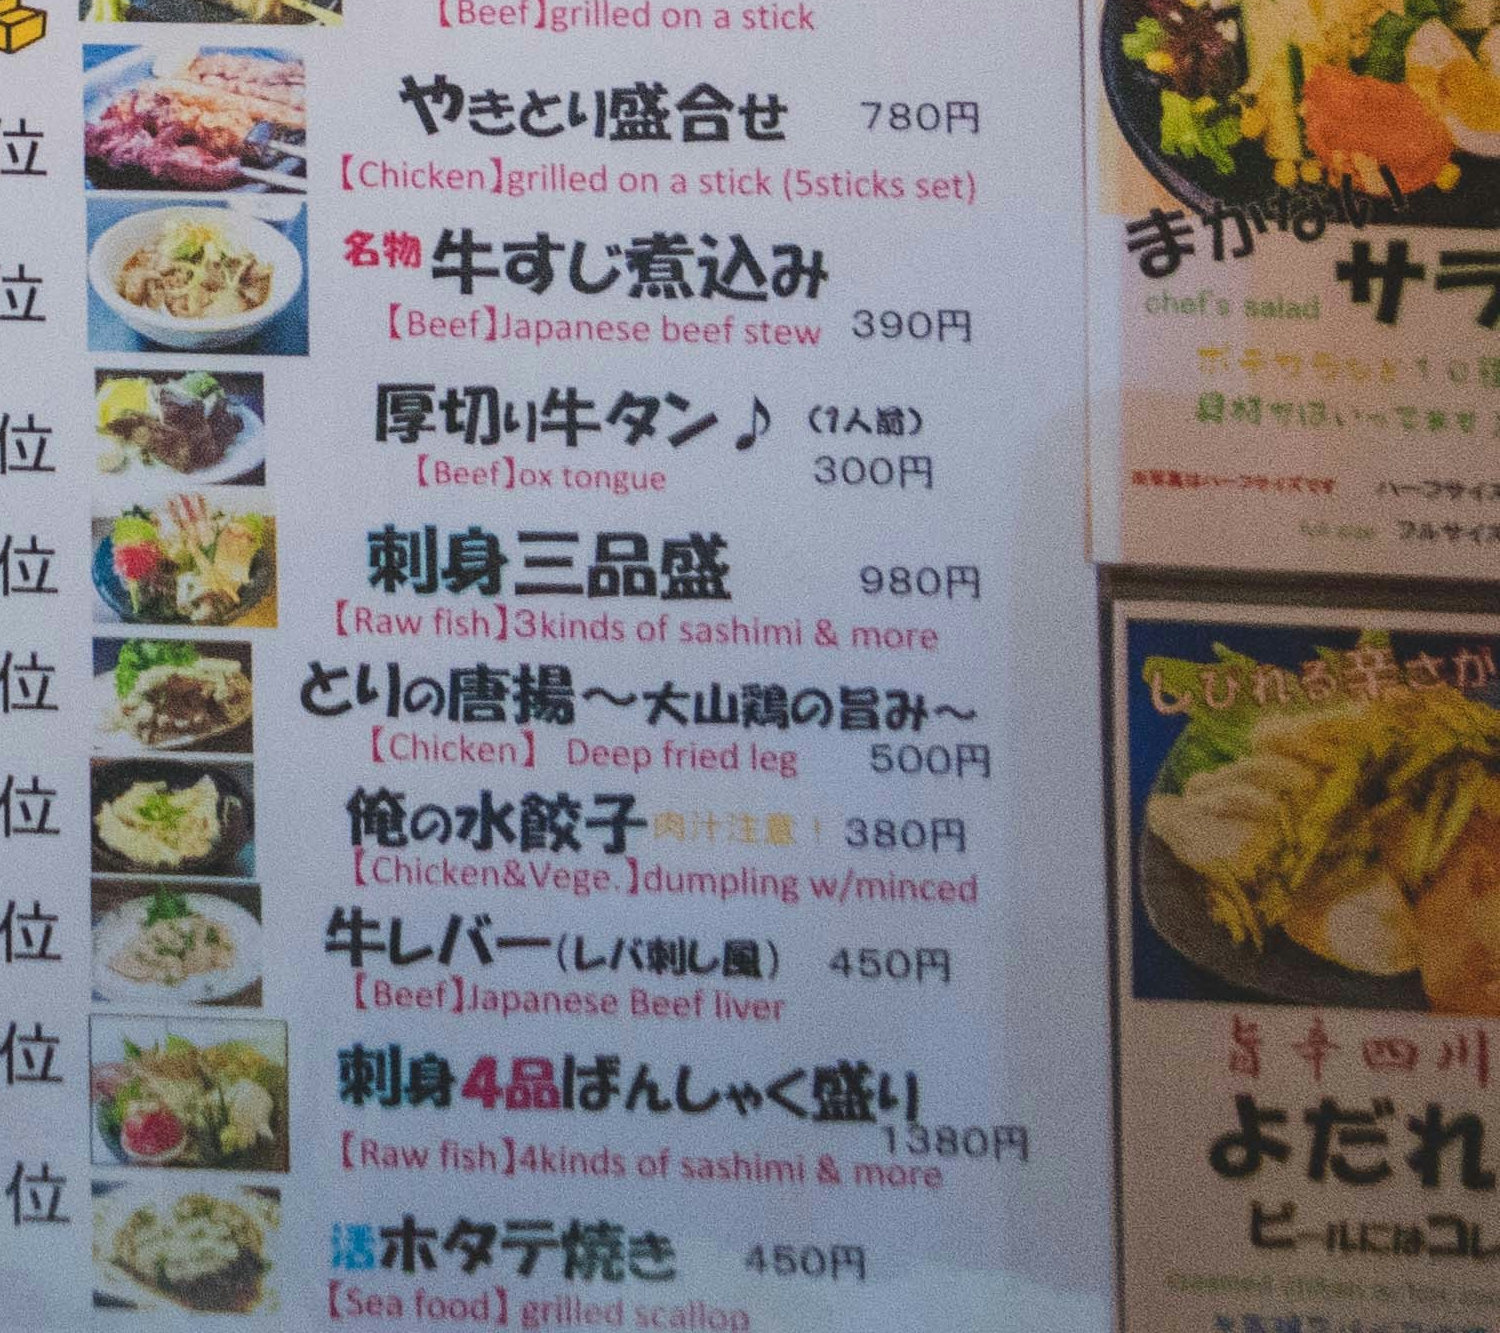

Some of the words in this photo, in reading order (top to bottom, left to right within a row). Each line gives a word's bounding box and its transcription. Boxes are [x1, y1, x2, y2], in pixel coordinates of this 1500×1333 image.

[742, 1, 816, 32] stick
[399, 73, 789, 143] やきとり盛合せ
[859, 100, 981, 134] 780円
[699, 164, 772, 196] stick
[343, 229, 423, 270] 名物
[430, 227, 830, 302] 牛すじ煮込み
[662, 312, 736, 344] beef
[744, 315, 822, 346] stew
[851, 307, 973, 344] 390円
[562, 463, 667, 496] tongue
[812, 455, 934, 490] 300円
[366, 524, 733, 602] 刺身三品盛
[859, 564, 982, 601] 980円
[676, 612, 804, 647] sashimi
[851, 625, 941, 651] more
[566, 739, 652, 774] Deep
[661, 740, 740, 774] fried
[749, 743, 800, 779] leg
[869, 744, 993, 781] 500円
[346, 785, 649, 855] 俺の水餃子
[844, 817, 967, 854] 380円
[827, 947, 952, 986] 450円
[629, 985, 703, 1020] Beef
[713, 989, 787, 1023] liver
[879, 1126, 1030, 1164] 1380円
[678, 1147, 808, 1184] sashimi
[853, 1160, 945, 1190] more
[744, 1243, 867, 1284] 450円
